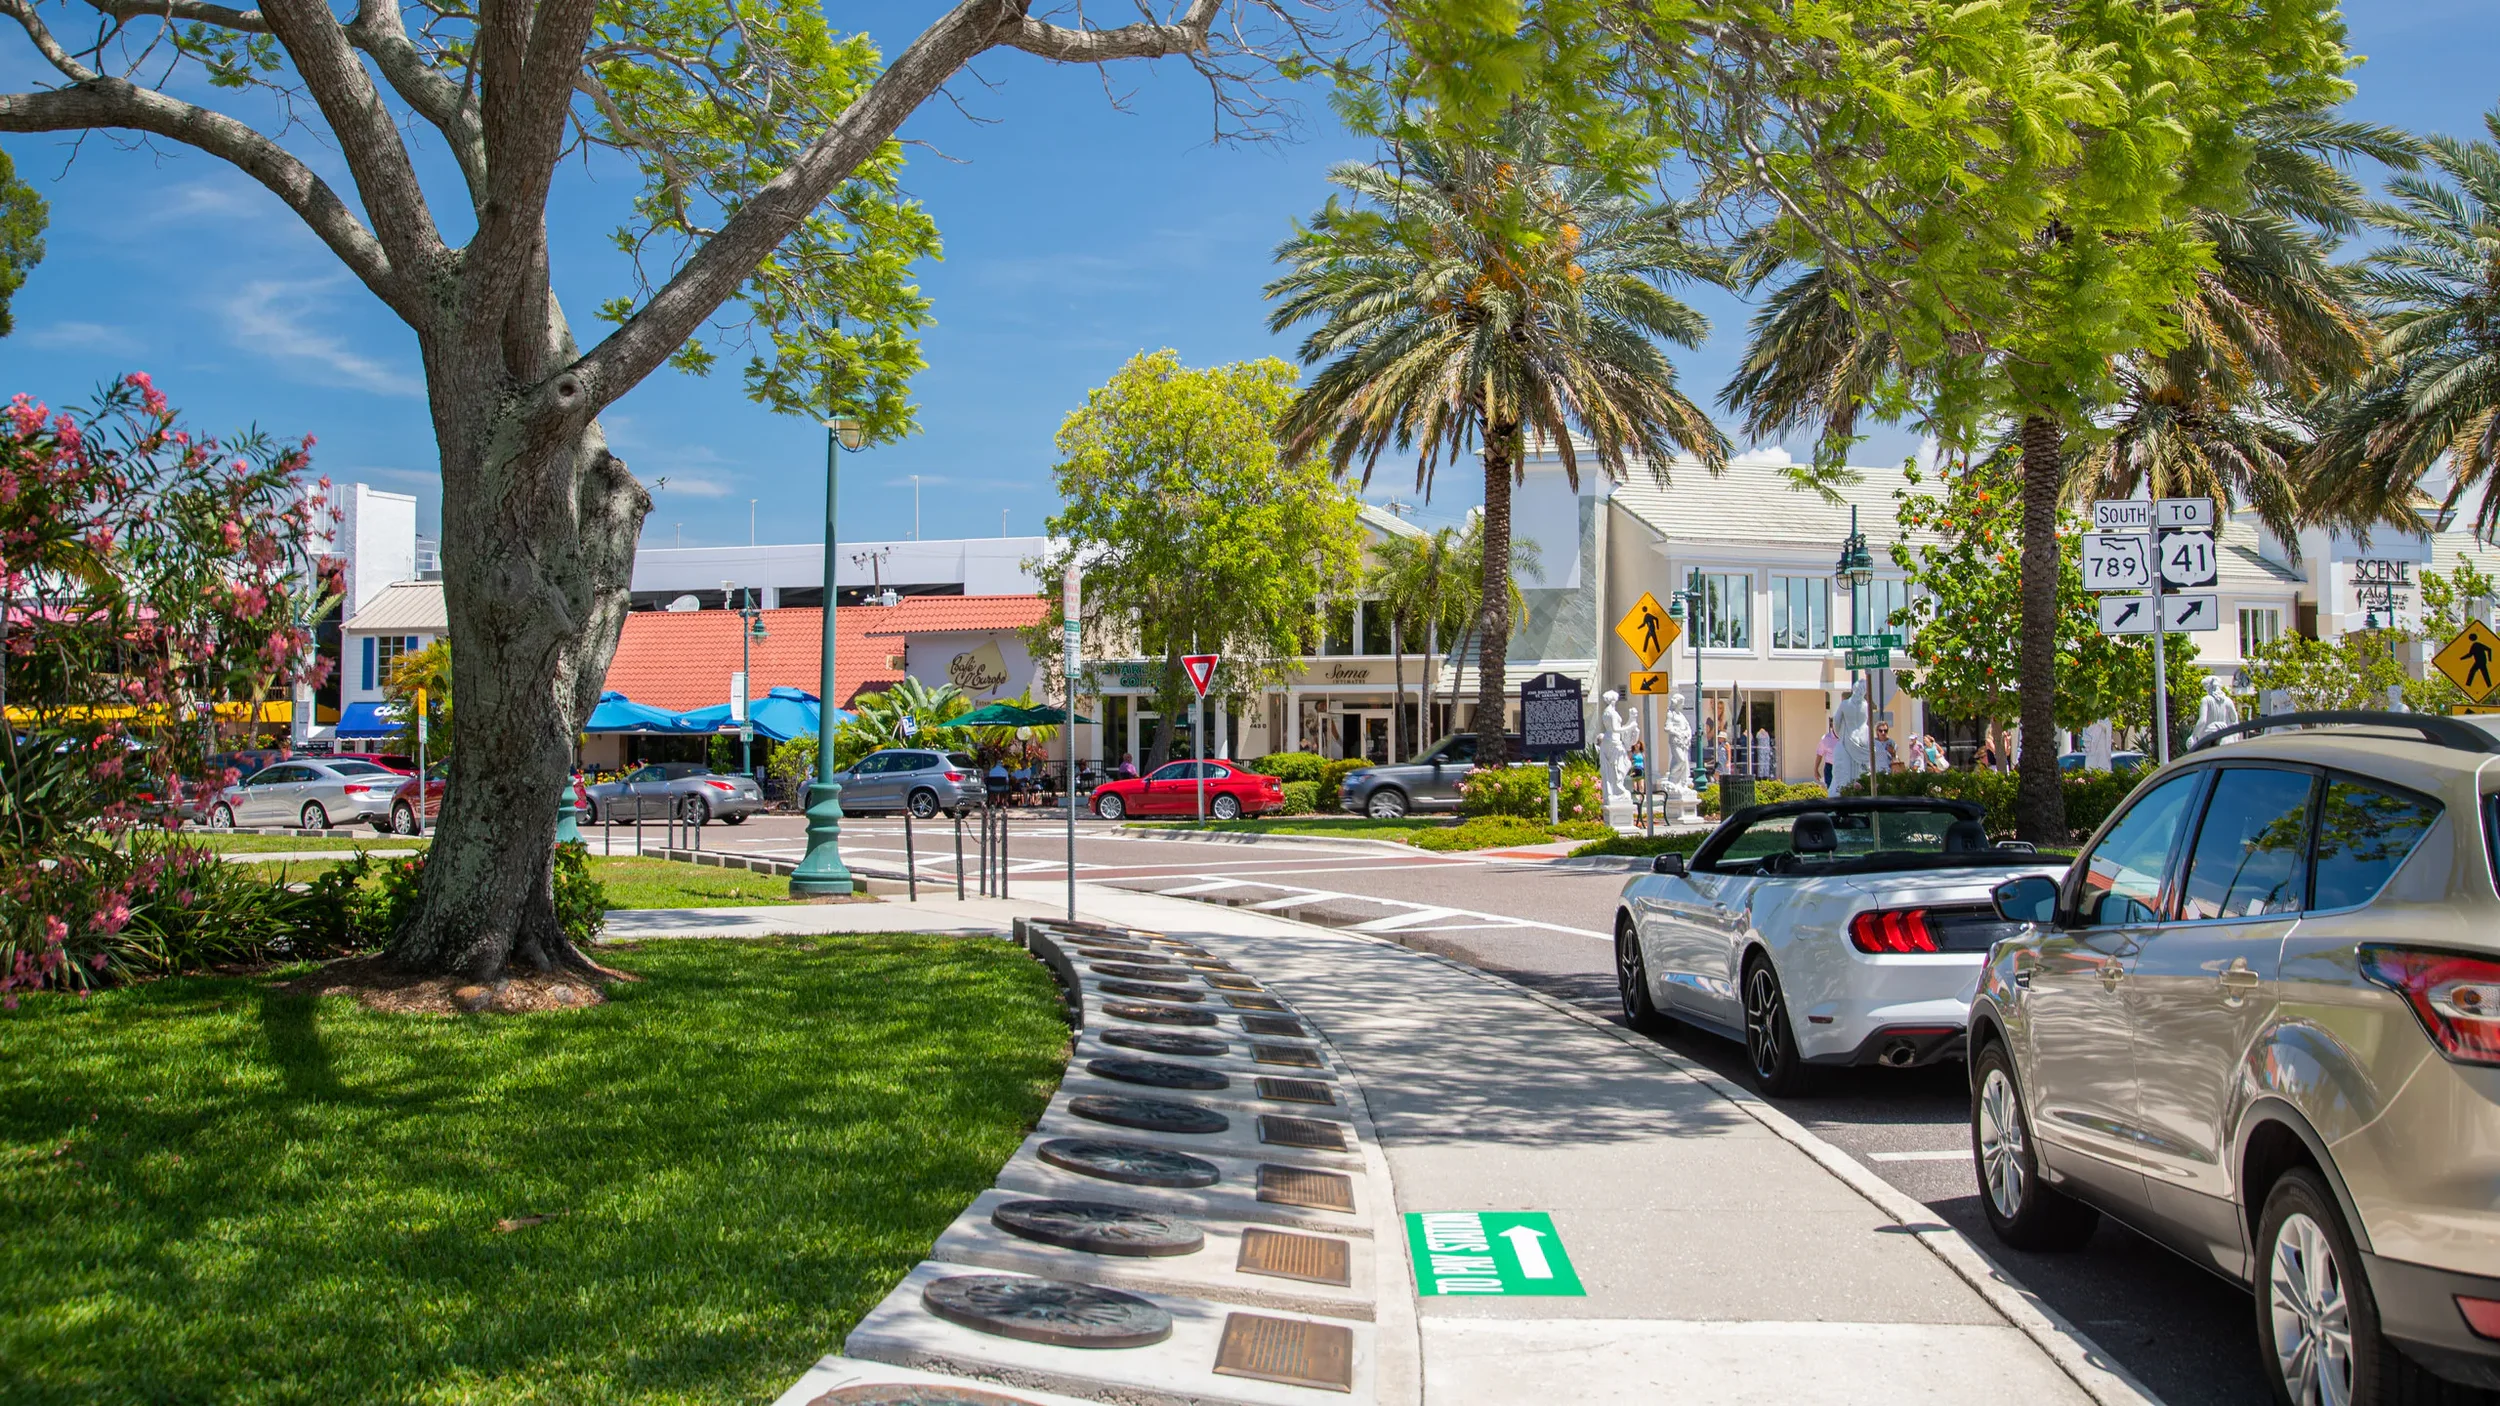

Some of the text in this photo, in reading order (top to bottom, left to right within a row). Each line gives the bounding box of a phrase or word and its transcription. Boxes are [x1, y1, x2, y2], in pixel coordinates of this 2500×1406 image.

[2099, 506, 2146, 523] SOUTH
[2170, 505, 2197, 520] TO
[2171, 544, 2206, 572] 41
[2090, 557, 2136, 577] 789
[2356, 559, 2410, 580] SCENE
[1836, 636, 1853, 647] John
[1853, 635, 1881, 647] Ringling
[1856, 652, 1879, 666] Armands
[1325, 664, 1370, 679] Soma
[1420, 1212, 1505, 1294] TO PAY STATION
